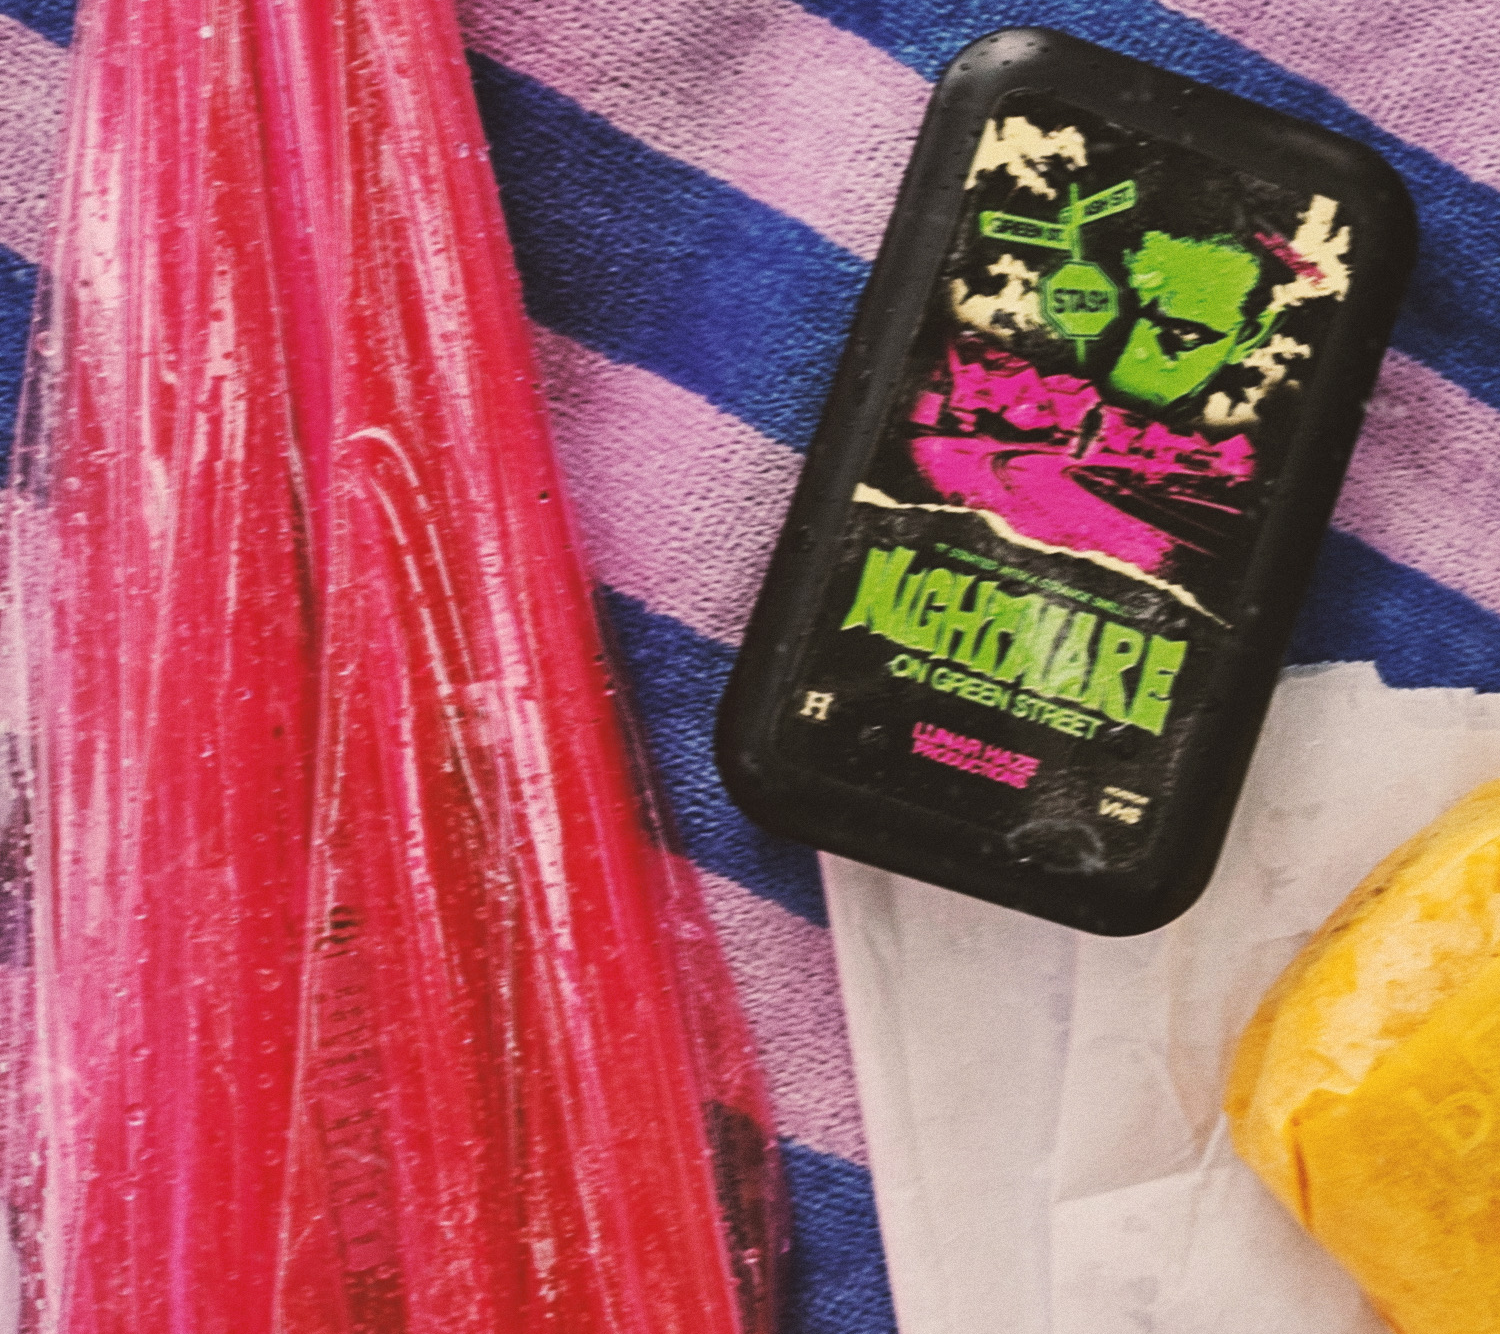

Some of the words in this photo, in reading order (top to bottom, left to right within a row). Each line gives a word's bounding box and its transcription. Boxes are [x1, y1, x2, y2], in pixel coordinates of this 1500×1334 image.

[1052, 287, 1110, 314] STASH
[840, 546, 1188, 736] NIGHTMARE
[887, 653, 931, 684] ON
[931, 667, 1011, 711] GREEN
[1011, 693, 1105, 740] STREET
[982, 745, 1041, 777] HAZE
